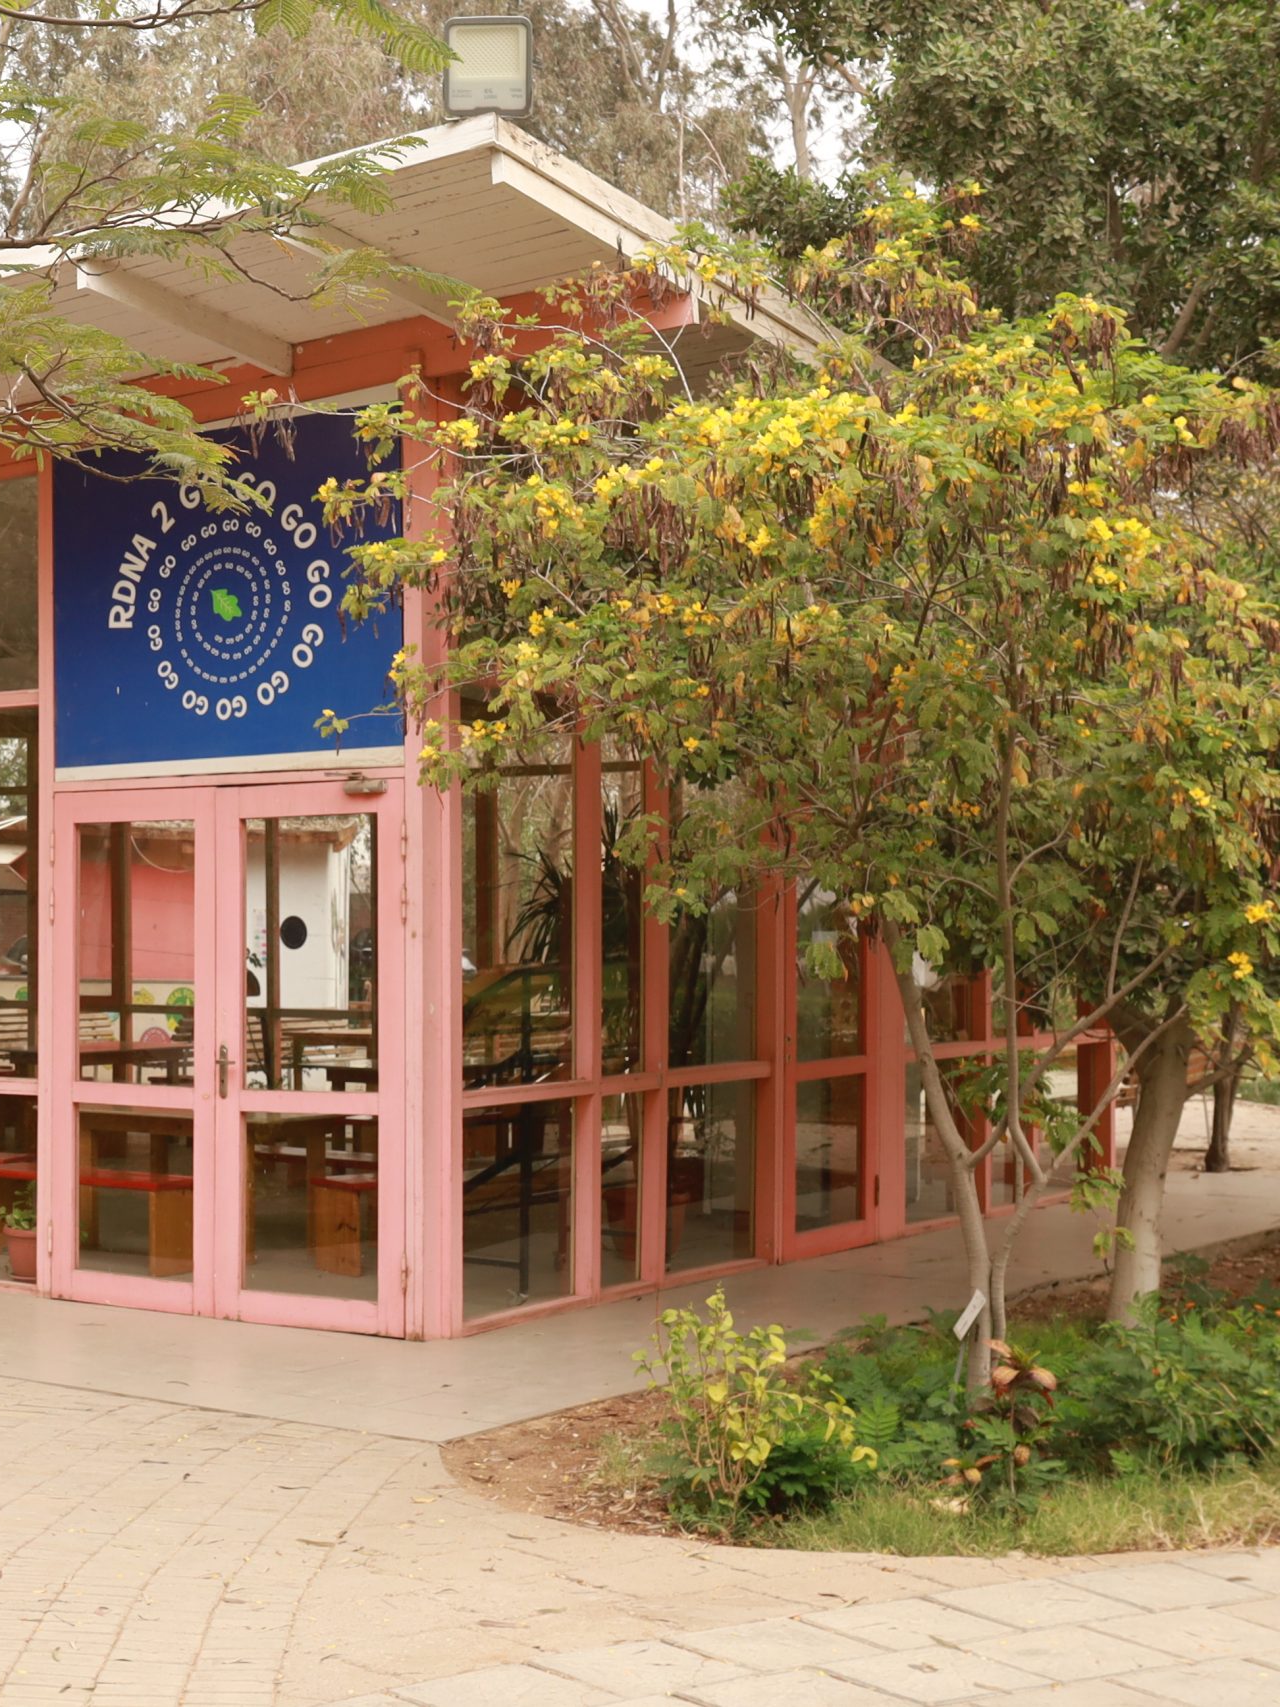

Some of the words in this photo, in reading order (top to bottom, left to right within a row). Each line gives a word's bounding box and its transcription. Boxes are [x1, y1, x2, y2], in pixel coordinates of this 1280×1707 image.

[151, 501, 176, 534] 2
[222, 518, 240, 532] GO
[245, 521, 262, 538] GO
[280, 503, 317, 549] GO
[180, 534, 197, 552] GO
[200, 523, 218, 539] GO
[263, 538, 277, 556] GO
[159, 555, 177, 579] GO
[275, 559, 287, 576] GO
[108, 533, 157, 629] RDNA
[281, 580, 291, 596] GO
[306, 559, 333, 609] GO
[147, 588, 162, 613] GO
[147, 624, 163, 652] GO
[291, 623, 325, 669] GO
[157, 660, 179, 690] GO
[256, 670, 290, 706] GO
[181, 689, 209, 716] GO
[215, 695, 248, 721] GO
